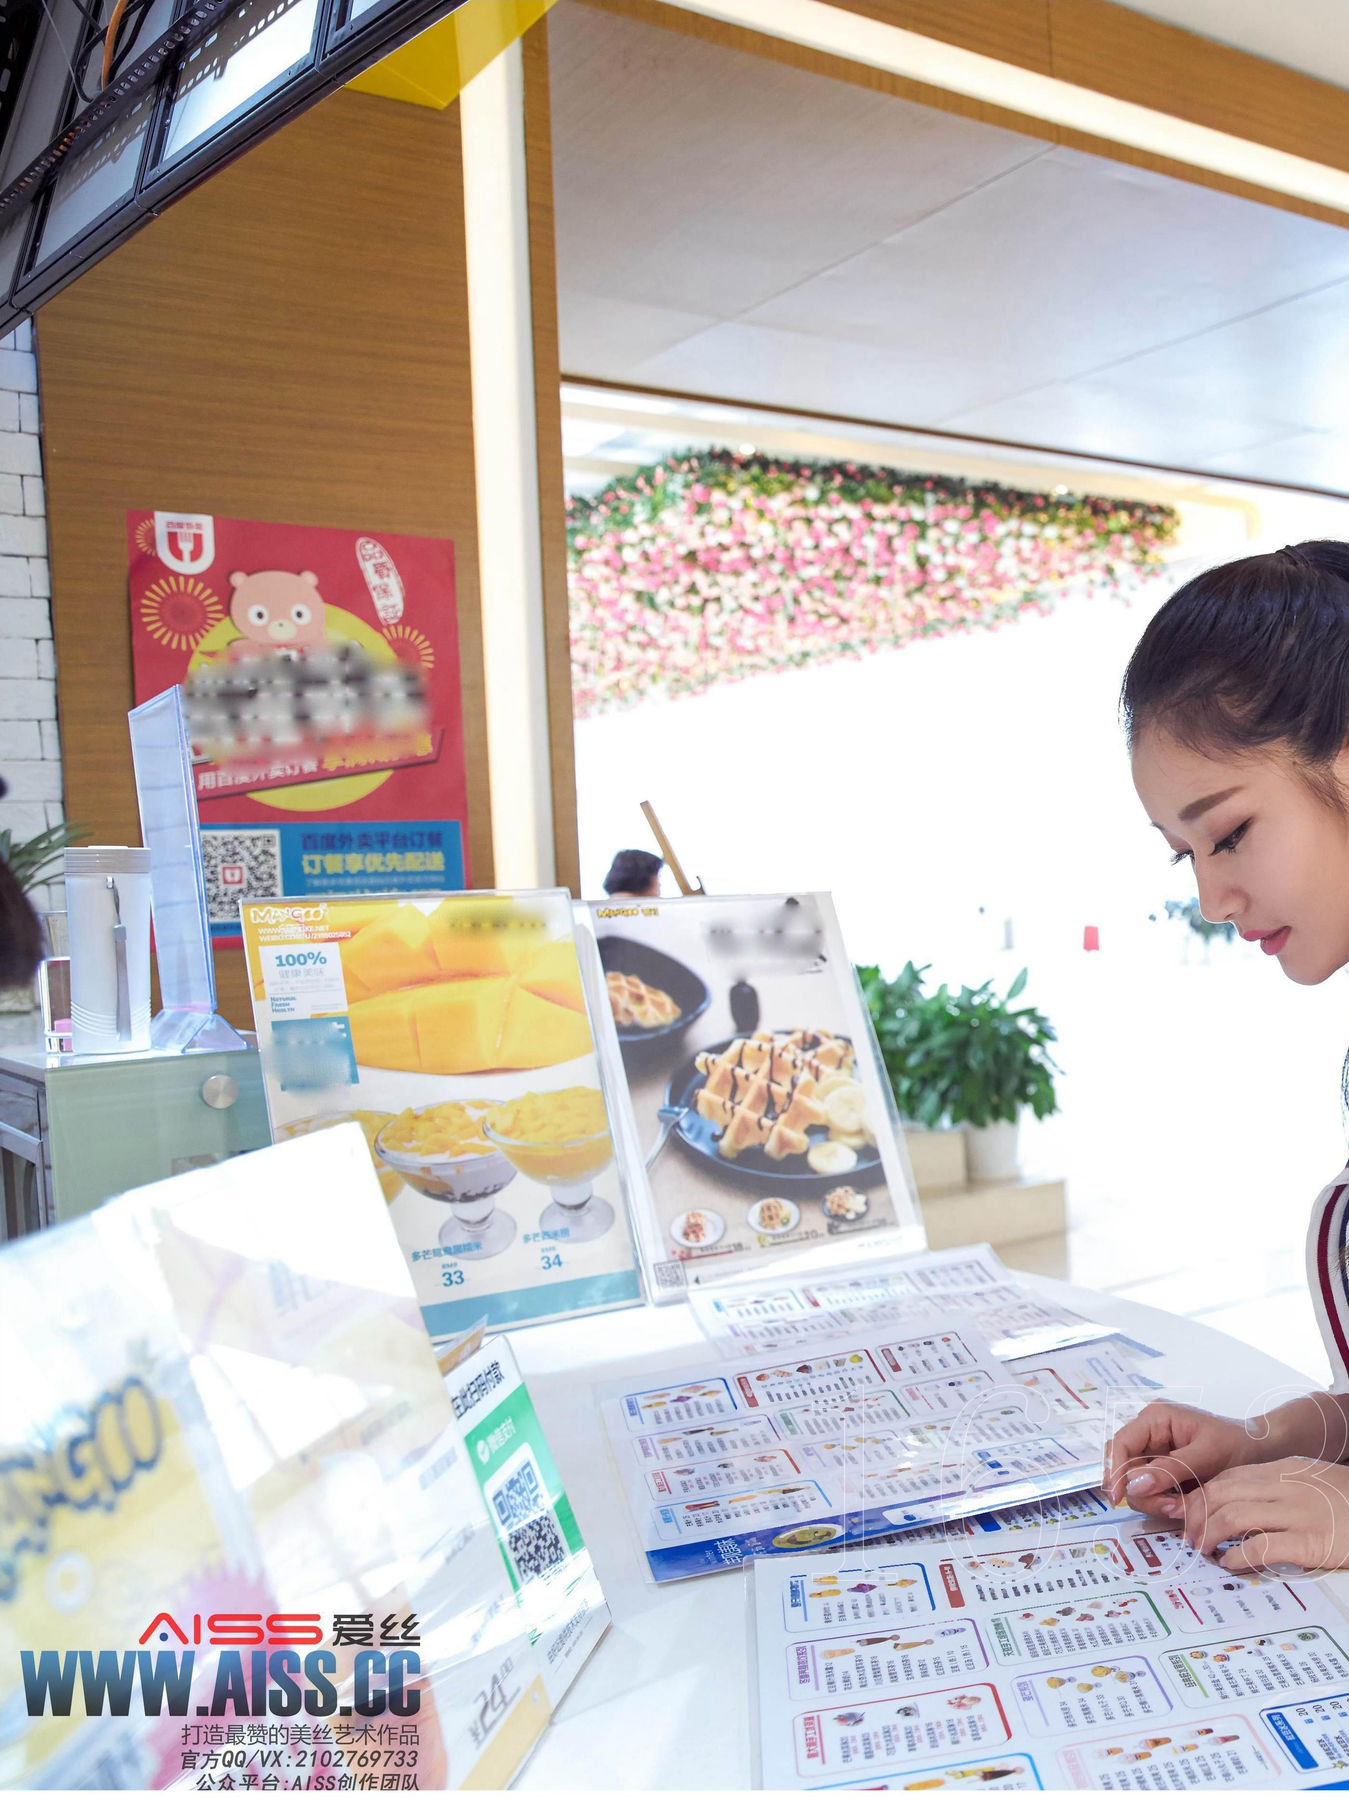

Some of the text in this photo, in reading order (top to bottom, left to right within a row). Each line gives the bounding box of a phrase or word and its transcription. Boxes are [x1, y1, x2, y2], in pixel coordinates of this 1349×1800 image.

[302, 831, 443, 850] 百度外卖平台订餐
[302, 851, 445, 875] 订餐享优先配送
[275, 951, 327, 967] 100%
[541, 1254, 563, 1270] 34
[441, 1270, 465, 1287] 33
